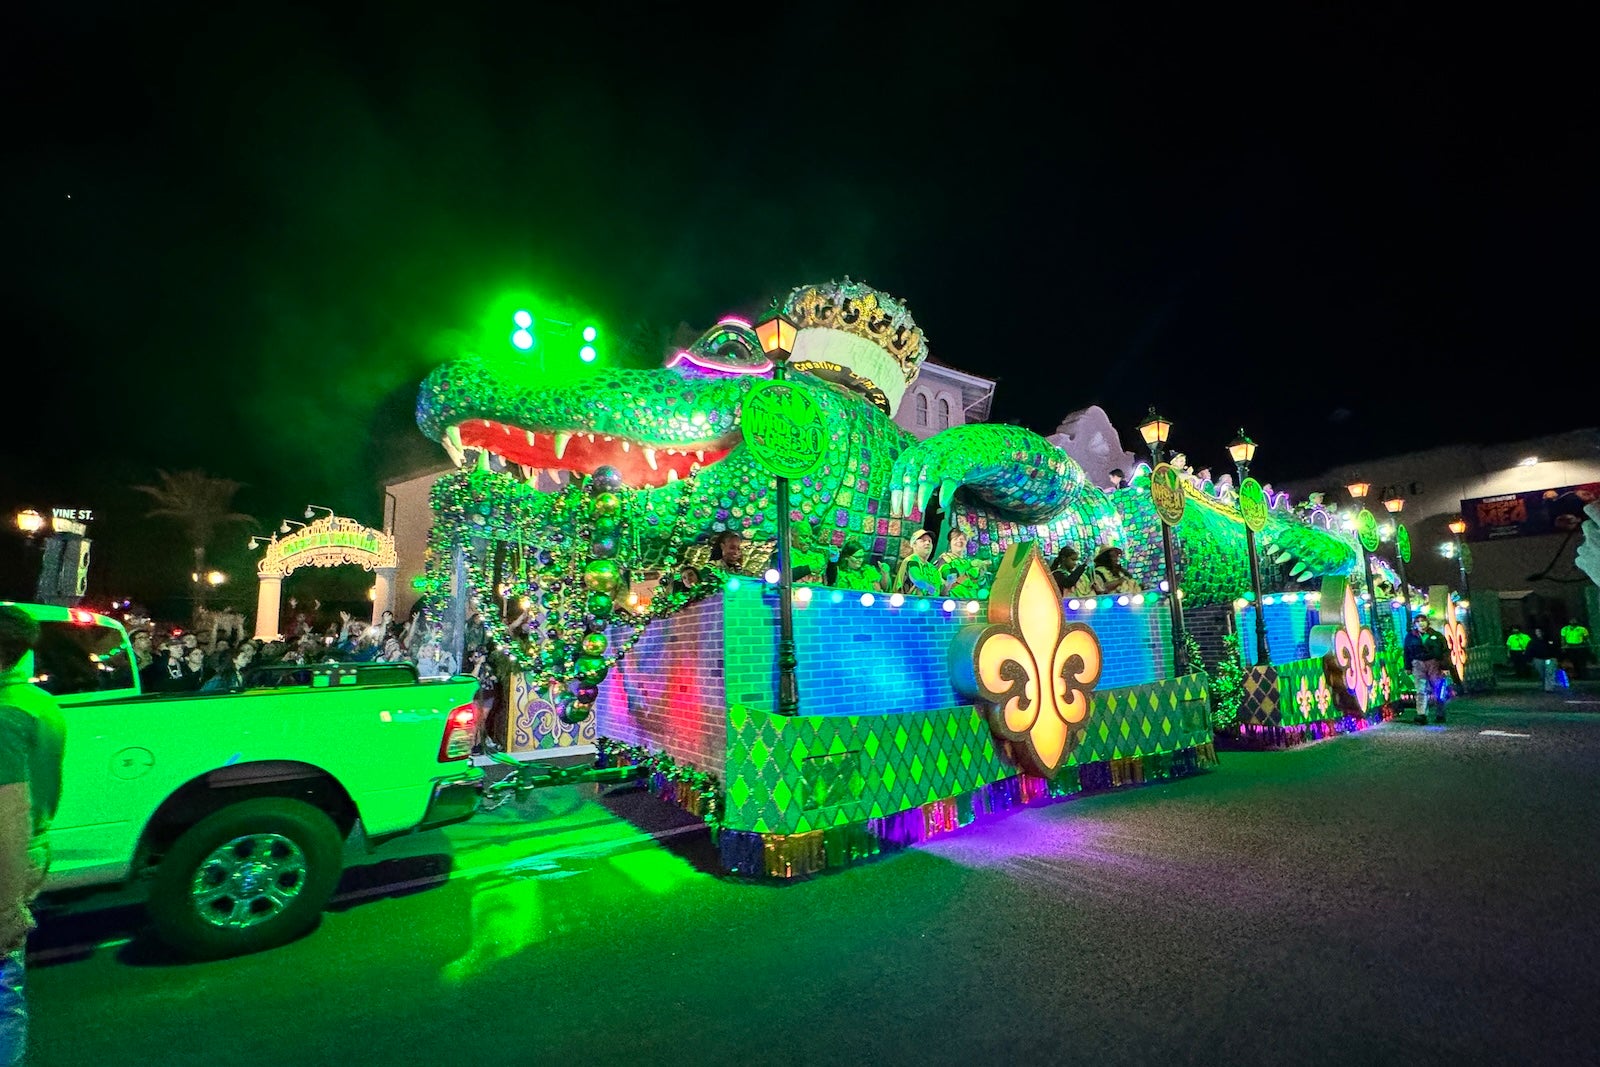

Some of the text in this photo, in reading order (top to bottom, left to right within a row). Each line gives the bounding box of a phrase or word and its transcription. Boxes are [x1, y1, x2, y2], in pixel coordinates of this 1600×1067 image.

[793, 361, 842, 372] Creative
[791, 425, 824, 453] 30
[52, 508, 94, 521] VINE ST.
